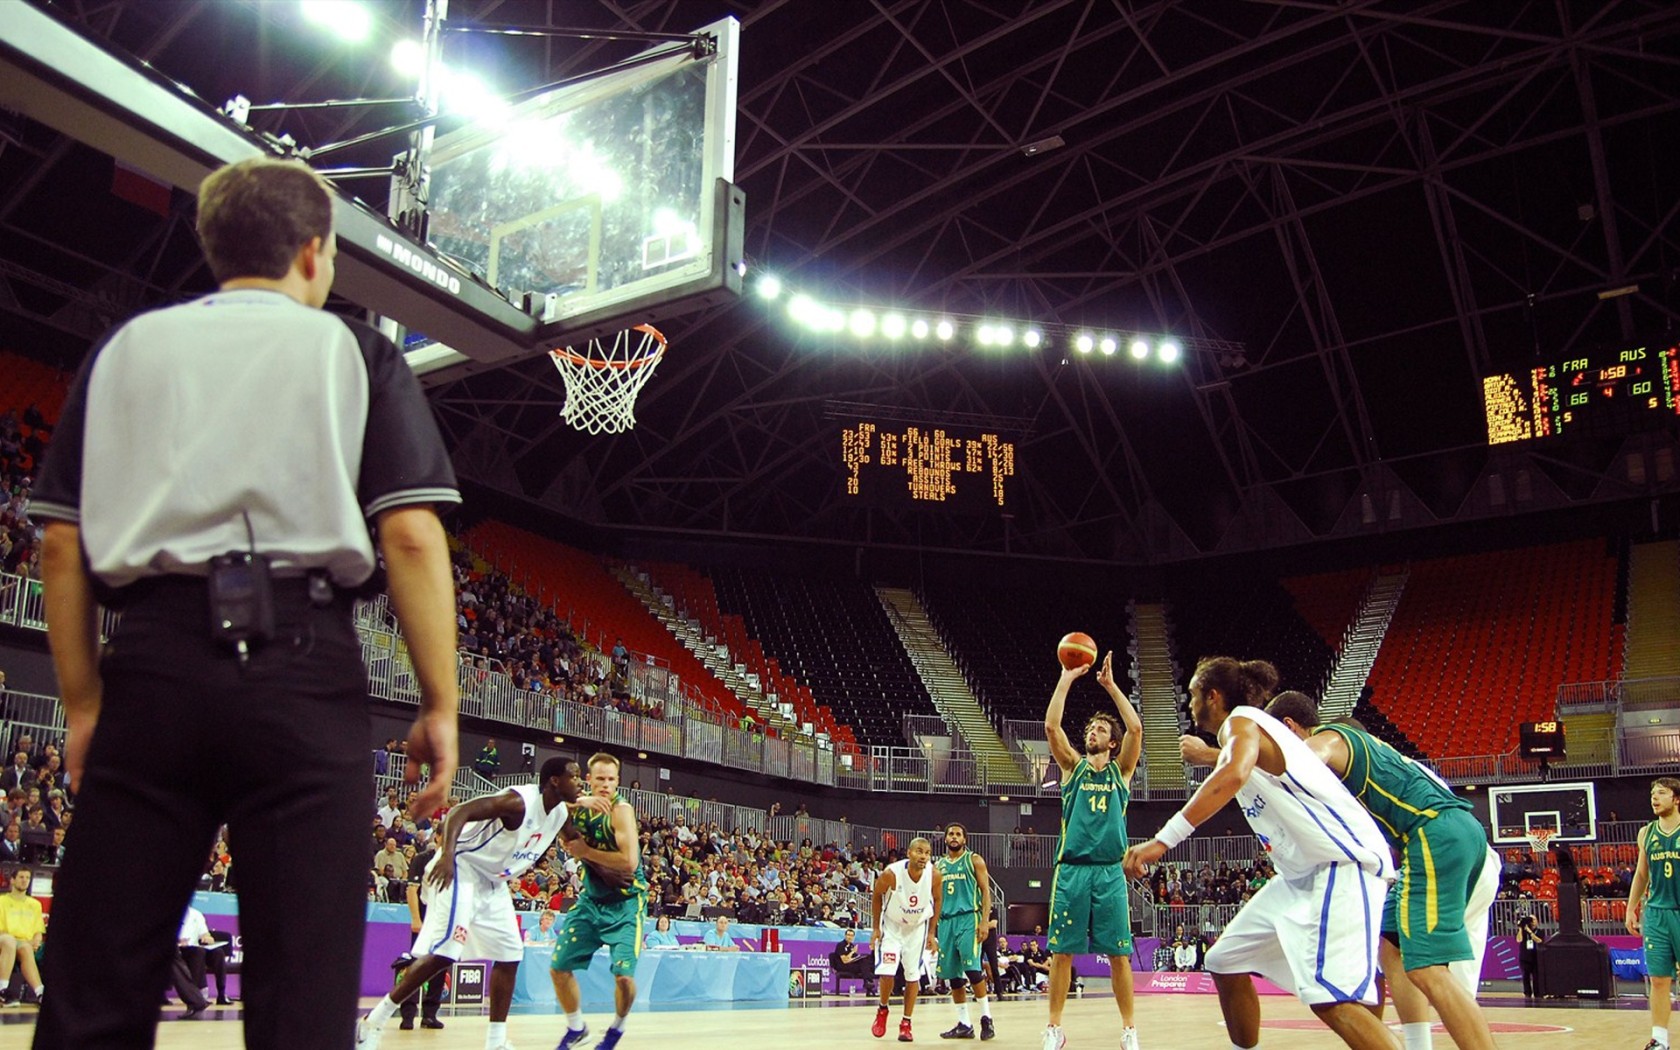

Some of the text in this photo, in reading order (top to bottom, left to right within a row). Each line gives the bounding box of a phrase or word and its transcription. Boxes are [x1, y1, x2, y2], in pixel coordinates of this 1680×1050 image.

[393, 243, 460, 294] MONDO
[1563, 347, 1647, 373] FRA AUS
[1600, 365, 1626, 380] 1:58
[1570, 392, 1588, 405] 66
[1603, 387, 1613, 397] 4
[1632, 381, 1651, 395] 60
[859, 423, 875, 432] FRA
[908, 428, 918, 436] 66
[934, 430, 945, 438] 60
[982, 434, 997, 443] AUS
[843, 430, 870, 440] 23/53
[902, 435, 929, 445] FIELD
[934, 437, 961, 448] GOALS
[987, 442, 1013, 452] 22/56
[843, 439, 870, 448] 22/43
[919, 444, 950, 454] POINTS
[988, 449, 1013, 459] 14/30
[843, 446, 864, 455] 1/10
[919, 452, 950, 462] POINTS
[843, 453, 870, 463] 19/30
[902, 458, 924, 468] FREE
[930, 460, 961, 471] THROWS
[848, 461, 858, 470] 43
[908, 466, 950, 478] REBOUNDS
[848, 478, 858, 486] 20
[908, 482, 956, 494] TURNOVERS
[913, 475, 950, 486] ASSISTS
[848, 486, 858, 494] 10
[913, 491, 945, 501] STEALS
[1534, 722, 1556, 732] 1:58
[1080, 783, 1116, 792] AUSTRALIA
[1088, 796, 1107, 812] 14
[942, 873, 967, 882] USTRALIA
[1664, 861, 1673, 879] 9
[947, 882, 955, 895] 5
[909, 895, 918, 907] 9
[807, 954, 830, 966] London
[460, 969, 481, 984] FIBA
[1151, 979, 1187, 989] Prepares
[1160, 974, 1188, 982] London
